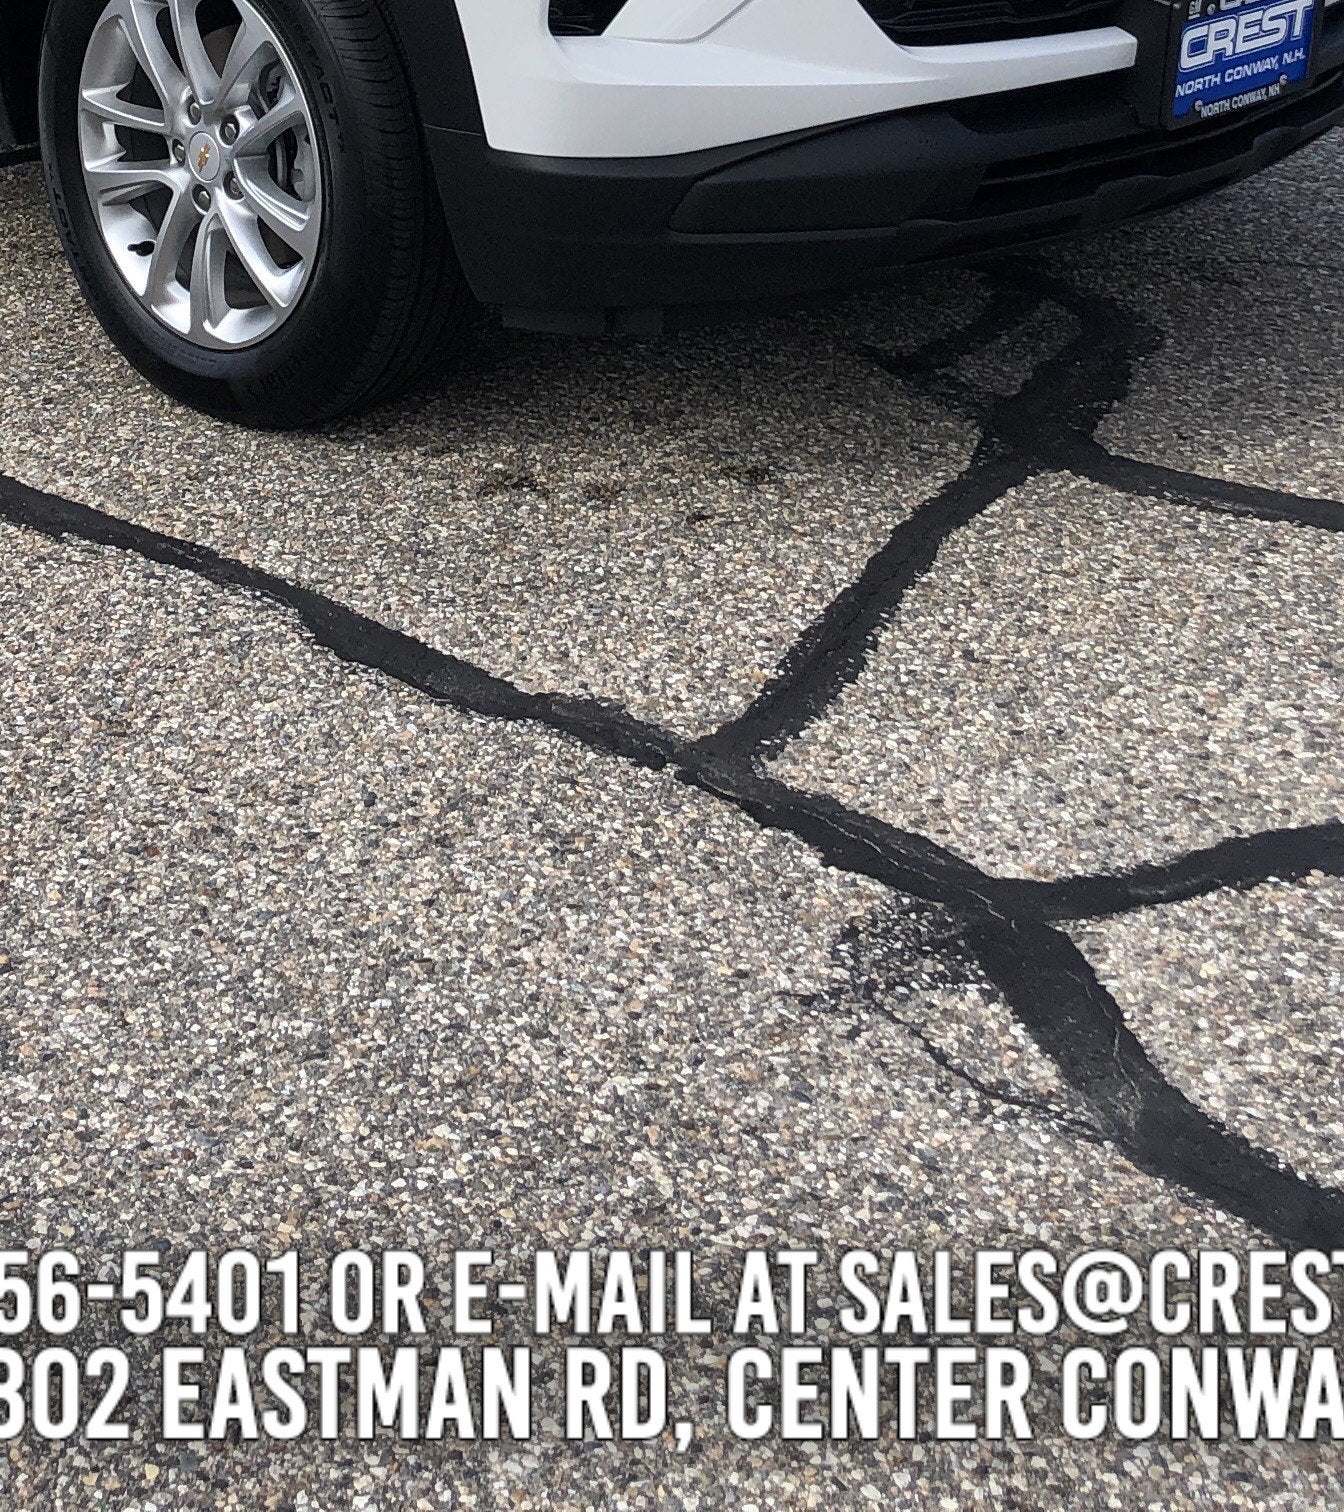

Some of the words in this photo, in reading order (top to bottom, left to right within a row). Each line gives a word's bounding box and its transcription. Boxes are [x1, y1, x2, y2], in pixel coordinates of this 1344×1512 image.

[1174, 73, 1221, 98] NORTH
[1224, 55, 1279, 83] CONWAY,
[1282, 47, 1306, 66] N.H.
[1200, 99, 1231, 118] NORTH
[1268, 83, 1281, 97] NH
